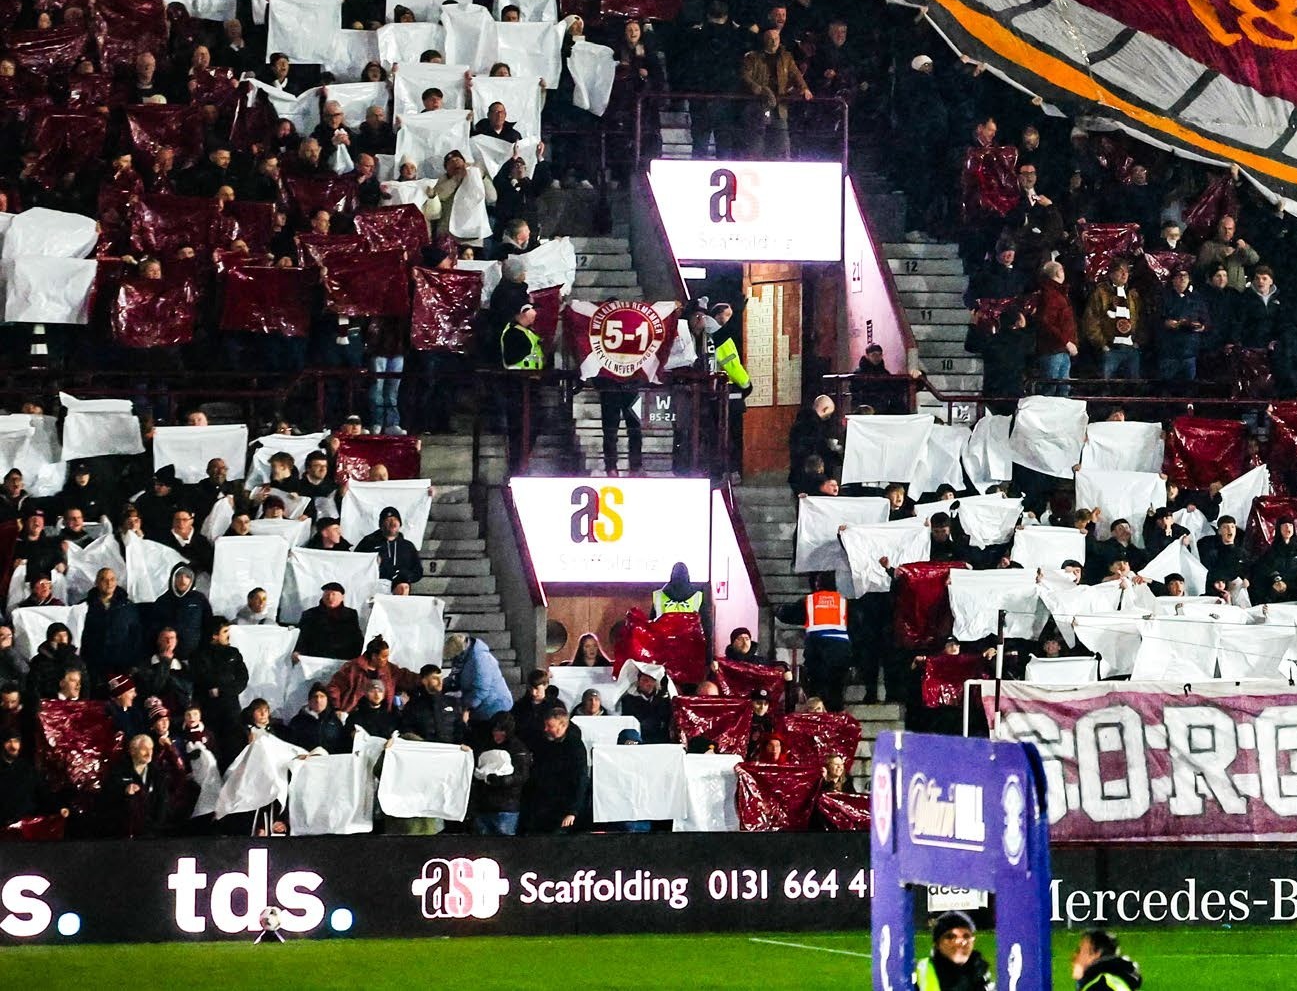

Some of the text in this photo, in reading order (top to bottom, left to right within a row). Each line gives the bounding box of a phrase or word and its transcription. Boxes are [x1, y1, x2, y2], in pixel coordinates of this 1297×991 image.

[905, 261, 918, 272] 12
[921, 311, 932, 320] 11
[603, 320, 649, 351] 5-1
[941, 360, 953, 370] 10
[656, 396, 671, 410] W
[571, 486, 624, 543] as
[430, 561, 437, 573] 8
[168, 848, 353, 934] tds.
[519, 870, 690, 909] Scaffolding
[708, 869, 768, 900] 0131
[783, 868, 838, 899] 664
